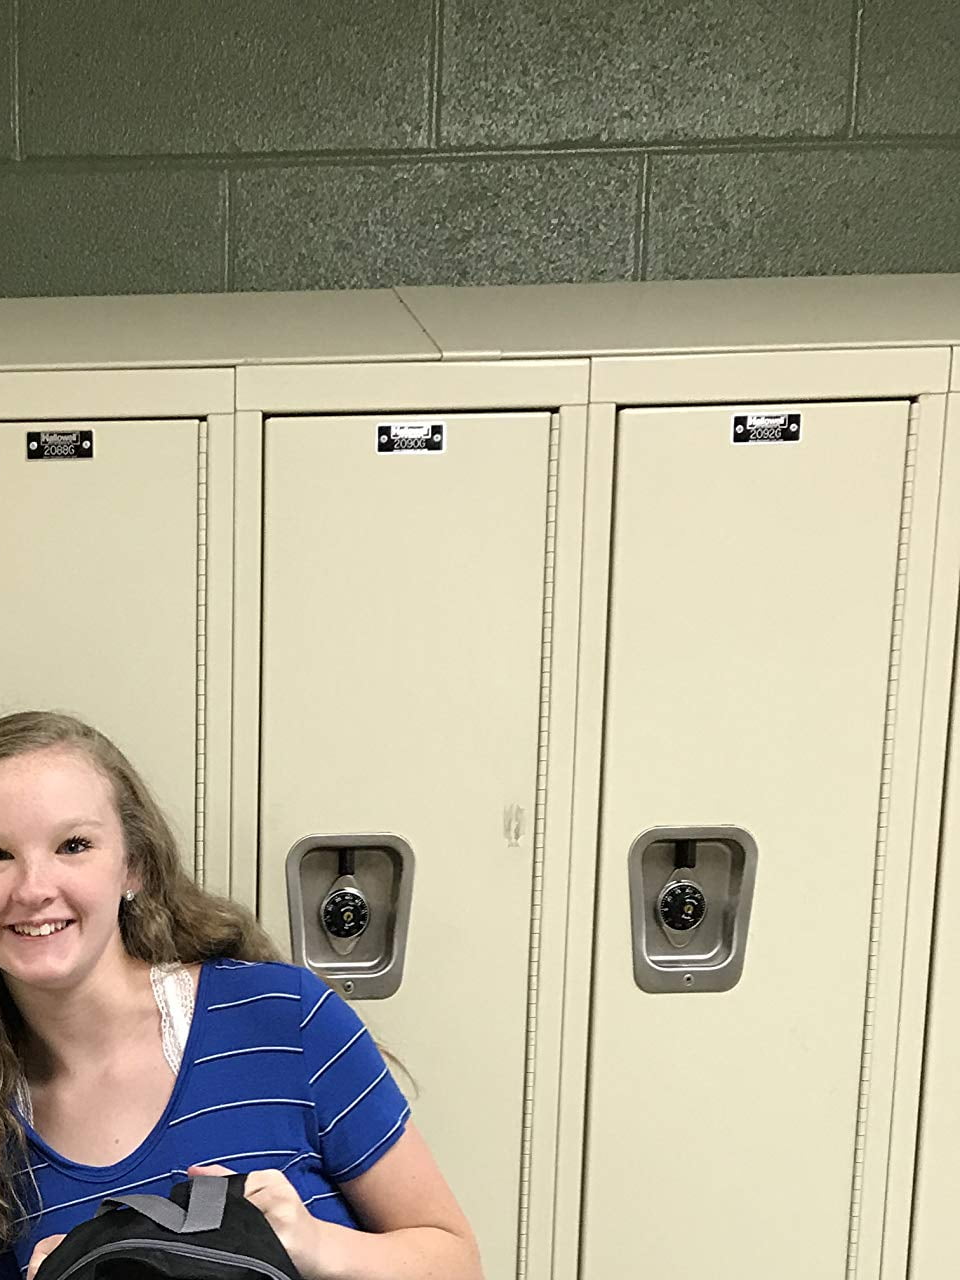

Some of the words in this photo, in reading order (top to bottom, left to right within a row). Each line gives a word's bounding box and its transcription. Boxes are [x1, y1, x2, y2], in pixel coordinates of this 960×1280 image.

[750, 428, 782, 439] 2092G
[394, 438, 426, 449] 2090G
[44, 445, 75, 456] 2088G
